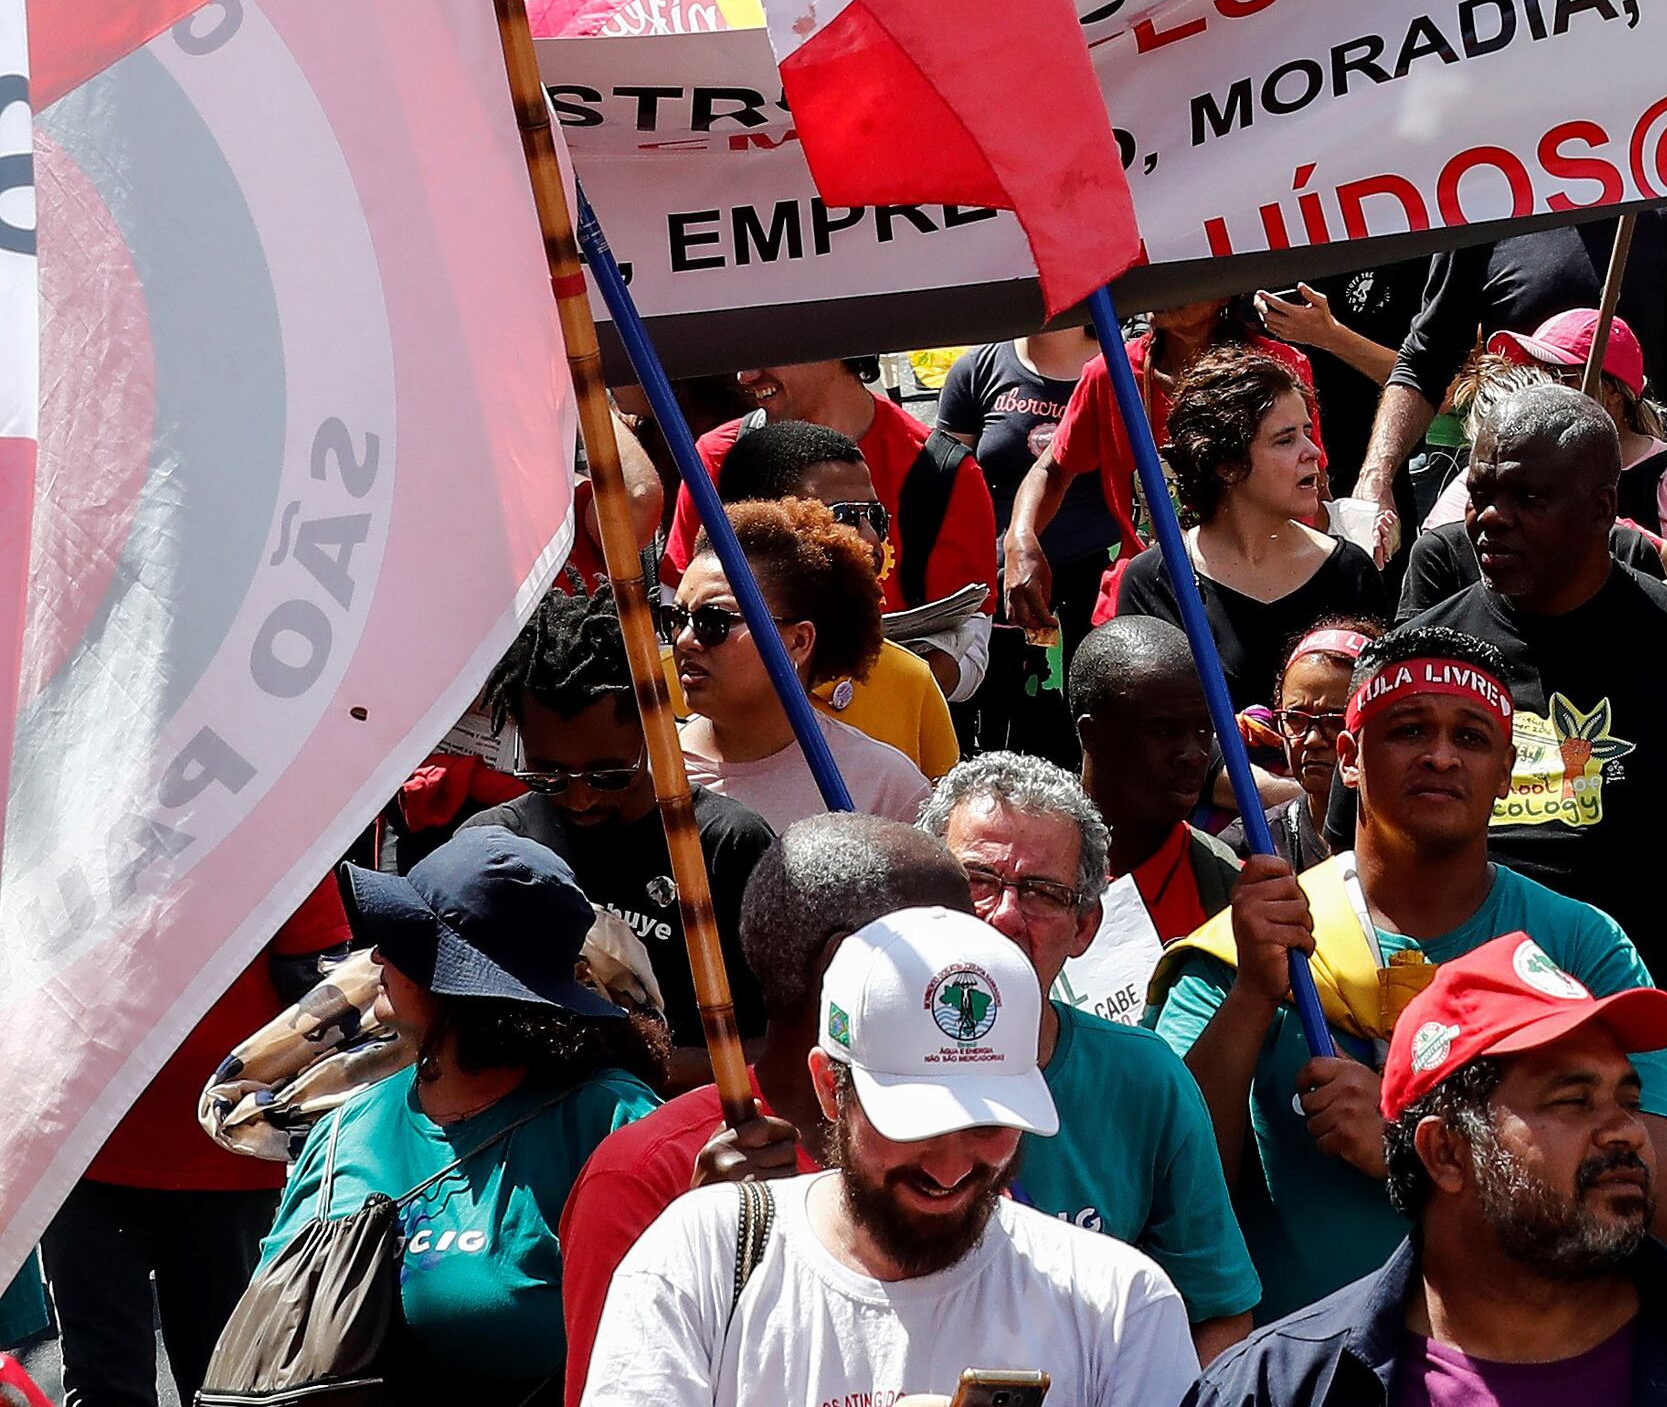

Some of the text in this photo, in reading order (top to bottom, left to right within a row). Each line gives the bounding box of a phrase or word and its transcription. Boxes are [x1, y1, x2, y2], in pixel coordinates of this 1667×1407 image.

[1357, 663, 1499, 713] LULA LIVRE
[1094, 982, 1141, 1021] CABE
